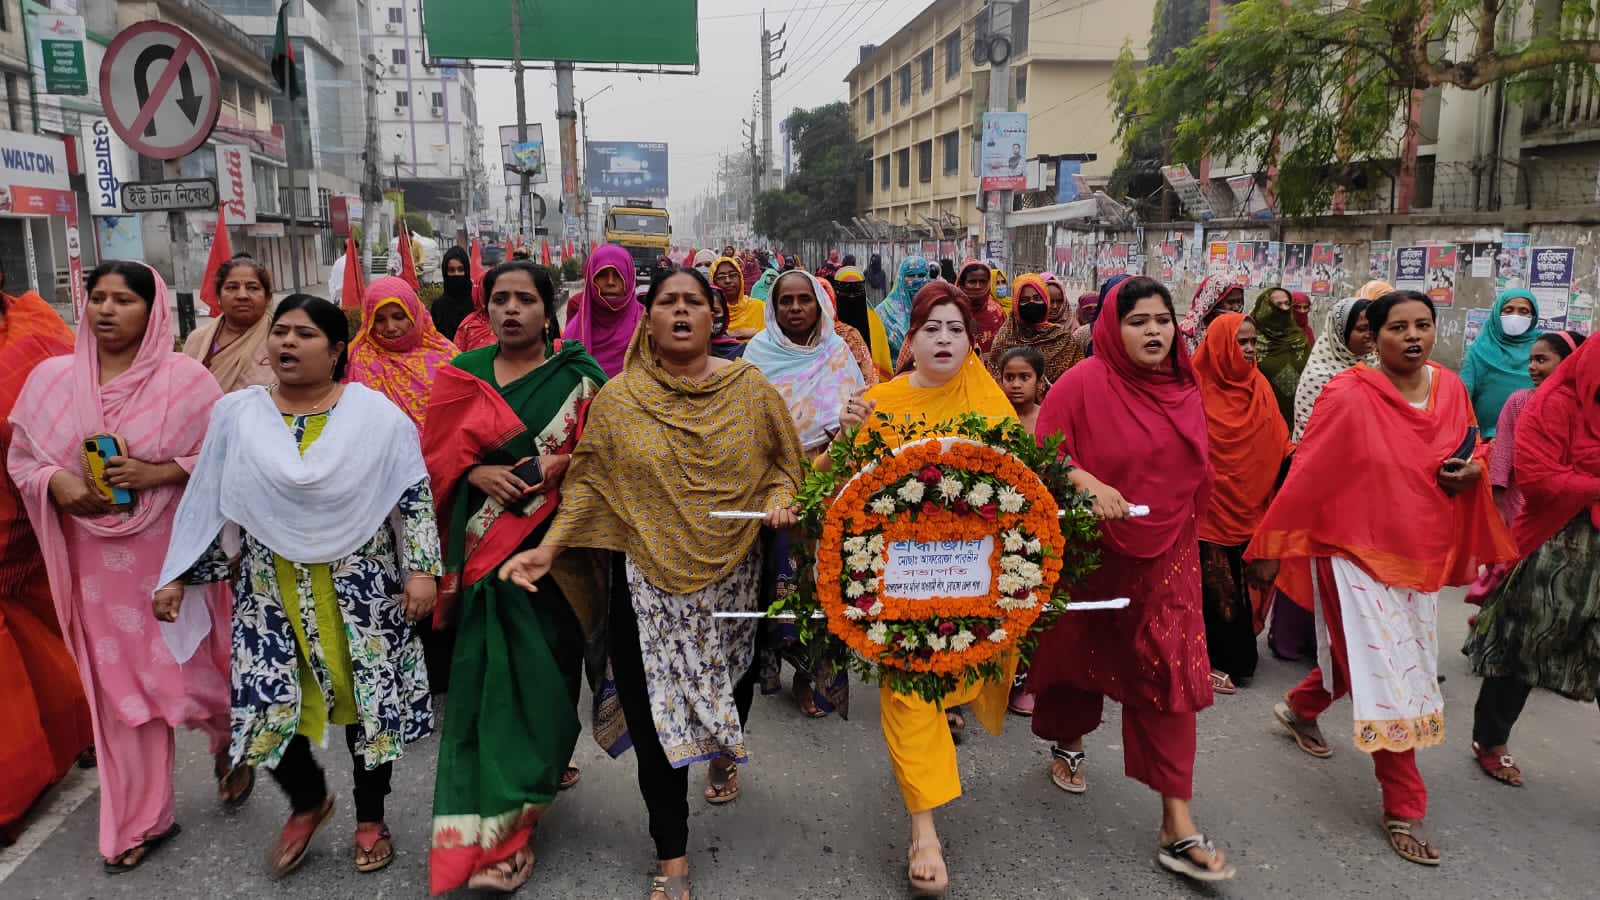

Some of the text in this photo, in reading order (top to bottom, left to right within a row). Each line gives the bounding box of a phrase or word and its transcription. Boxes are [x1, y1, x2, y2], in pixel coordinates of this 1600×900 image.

[1, 147, 55, 176] WALTON
[93, 120, 120, 209] ওয়ালটন
[128, 186, 146, 207] ইউ
[175, 183, 211, 204] নিষেধ
[223, 148, 247, 221] Bata
[903, 566, 968, 577] সভাপতি
